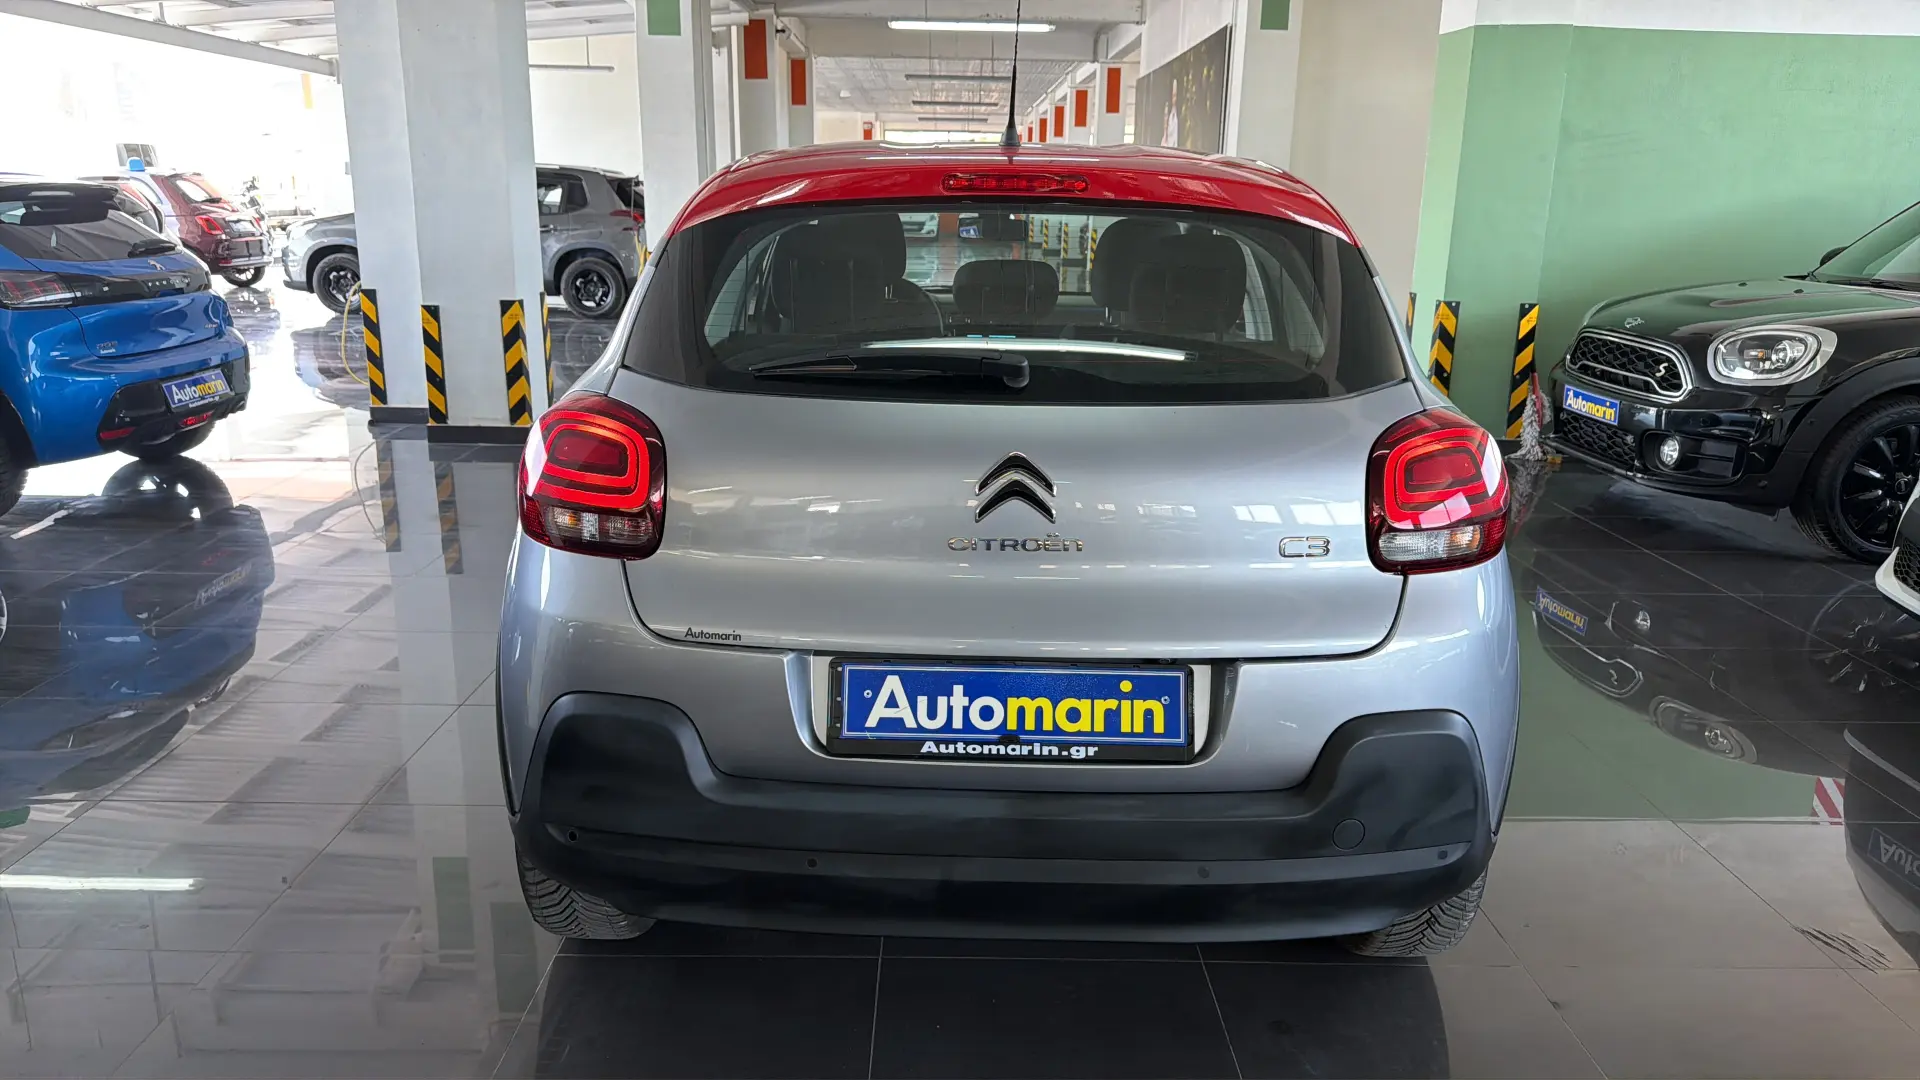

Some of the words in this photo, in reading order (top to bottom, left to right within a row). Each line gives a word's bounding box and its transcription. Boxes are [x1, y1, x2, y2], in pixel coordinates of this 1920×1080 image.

[1655, 362, 1669, 377] S
[171, 375, 226, 404] Automarin
[1565, 389, 1616, 422] Automarin
[1277, 535, 1332, 559] C3
[683, 626, 742, 642] Automarin
[864, 674, 1165, 734] Automarin
[920, 740, 1099, 758] Automarin.gr
